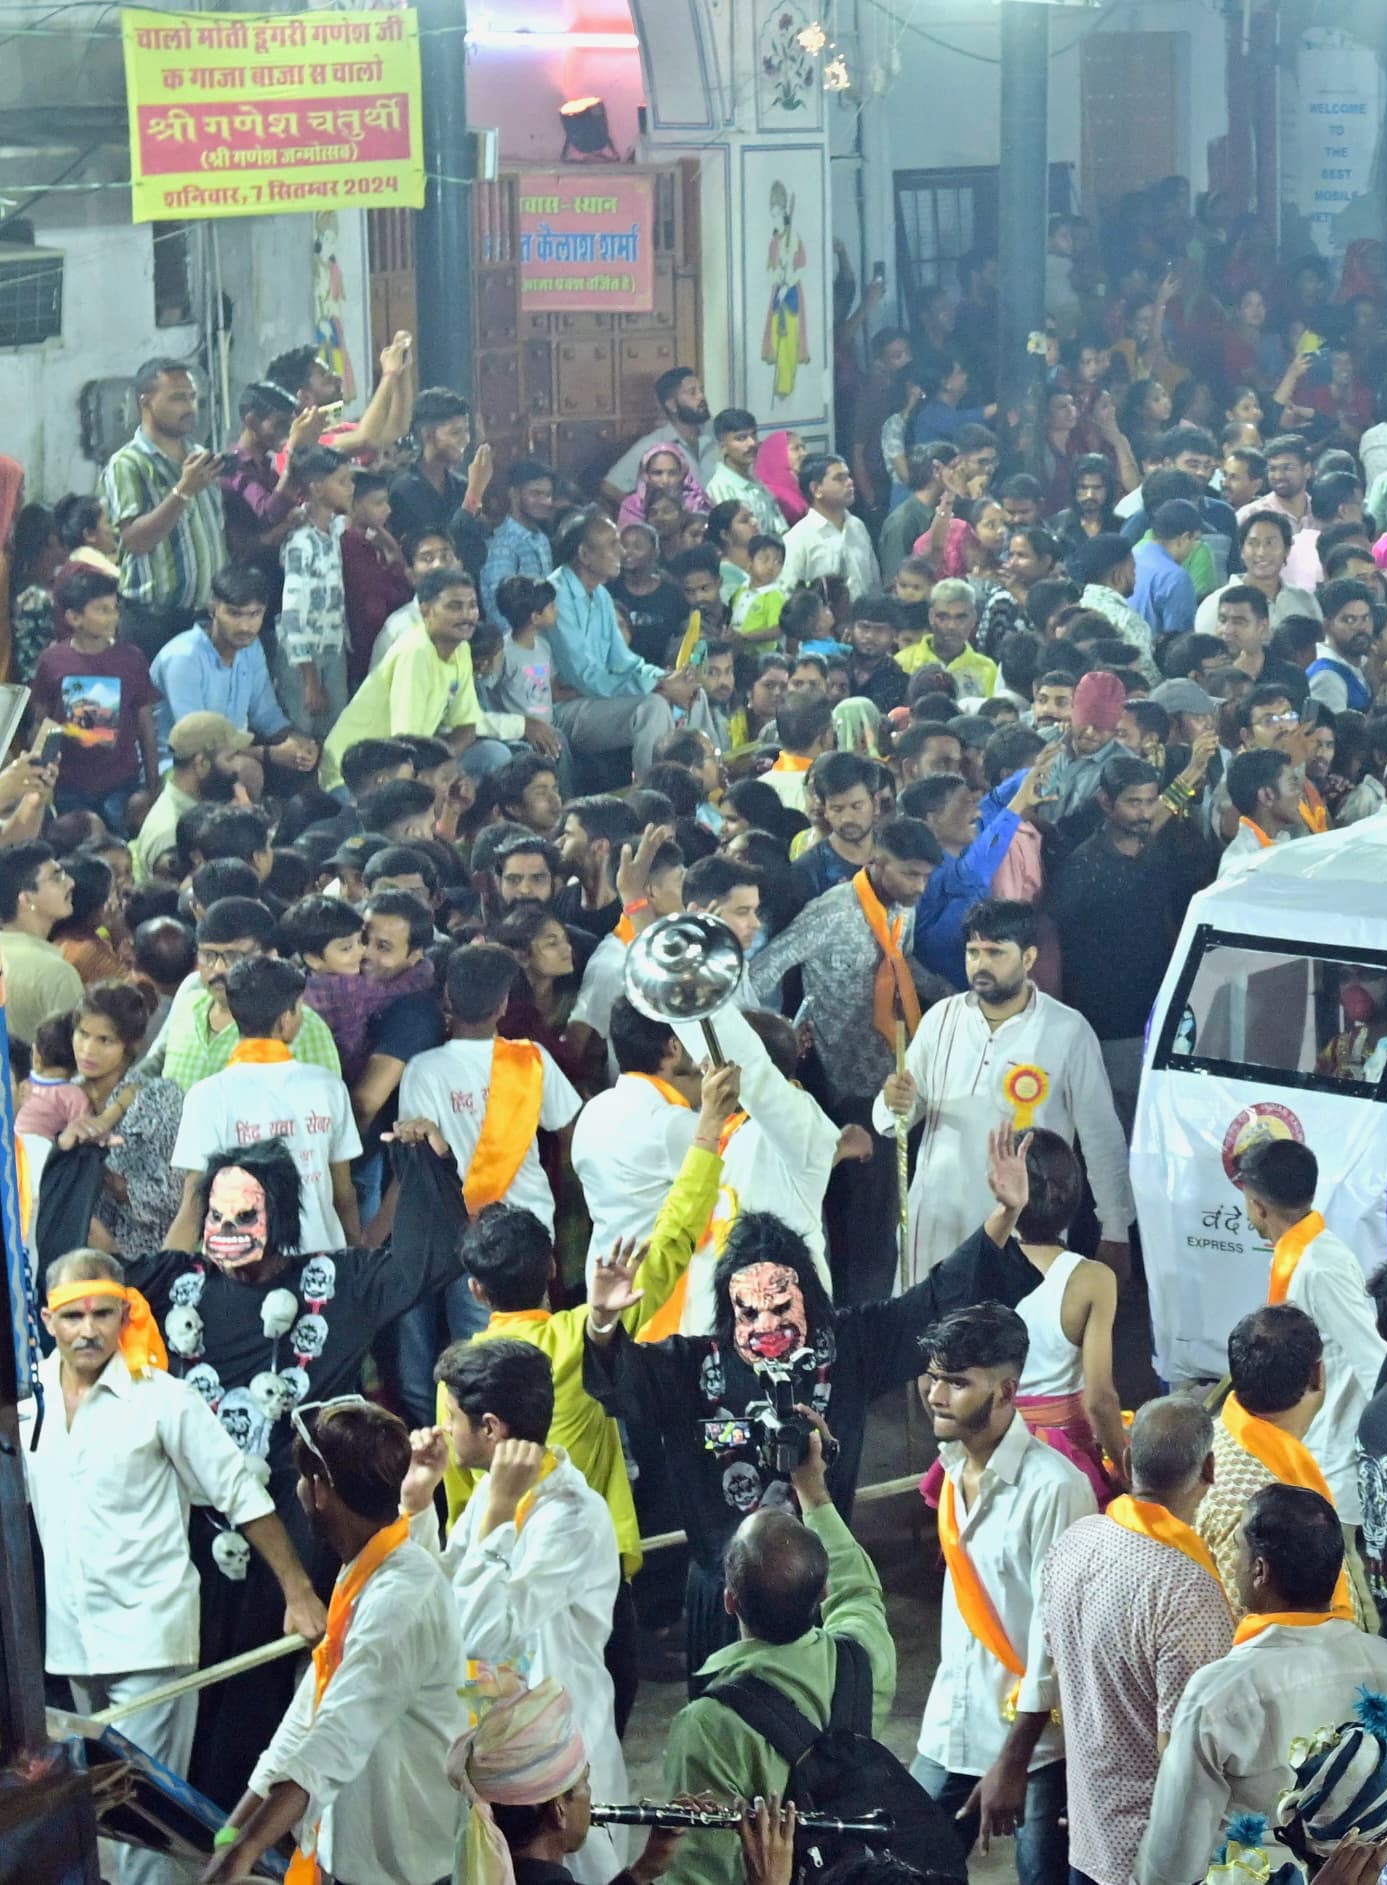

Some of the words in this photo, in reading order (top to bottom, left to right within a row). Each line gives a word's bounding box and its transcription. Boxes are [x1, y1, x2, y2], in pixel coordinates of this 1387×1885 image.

[135, 21, 192, 51] चालो
[197, 19, 249, 49] मोती
[312, 18, 370, 45] गणेश
[376, 15, 405, 42] जी
[1310, 103, 1367, 114] WELCOME
[147, 108, 199, 143] श्री
[202, 104, 301, 142] गणेश
[307, 97, 402, 143] चतुर्थी
[1328, 125, 1345, 136] TO
[1325, 147, 1350, 158] THE
[1321, 168, 1353, 180] BEST
[250, 185, 262, 202] 7
[343, 176, 399, 196] 2024
[1314, 190, 1360, 201] MOBILE
[1201, 1205, 1242, 1236] वंदे
[1187, 1235, 1245, 1255] EXPRESS
